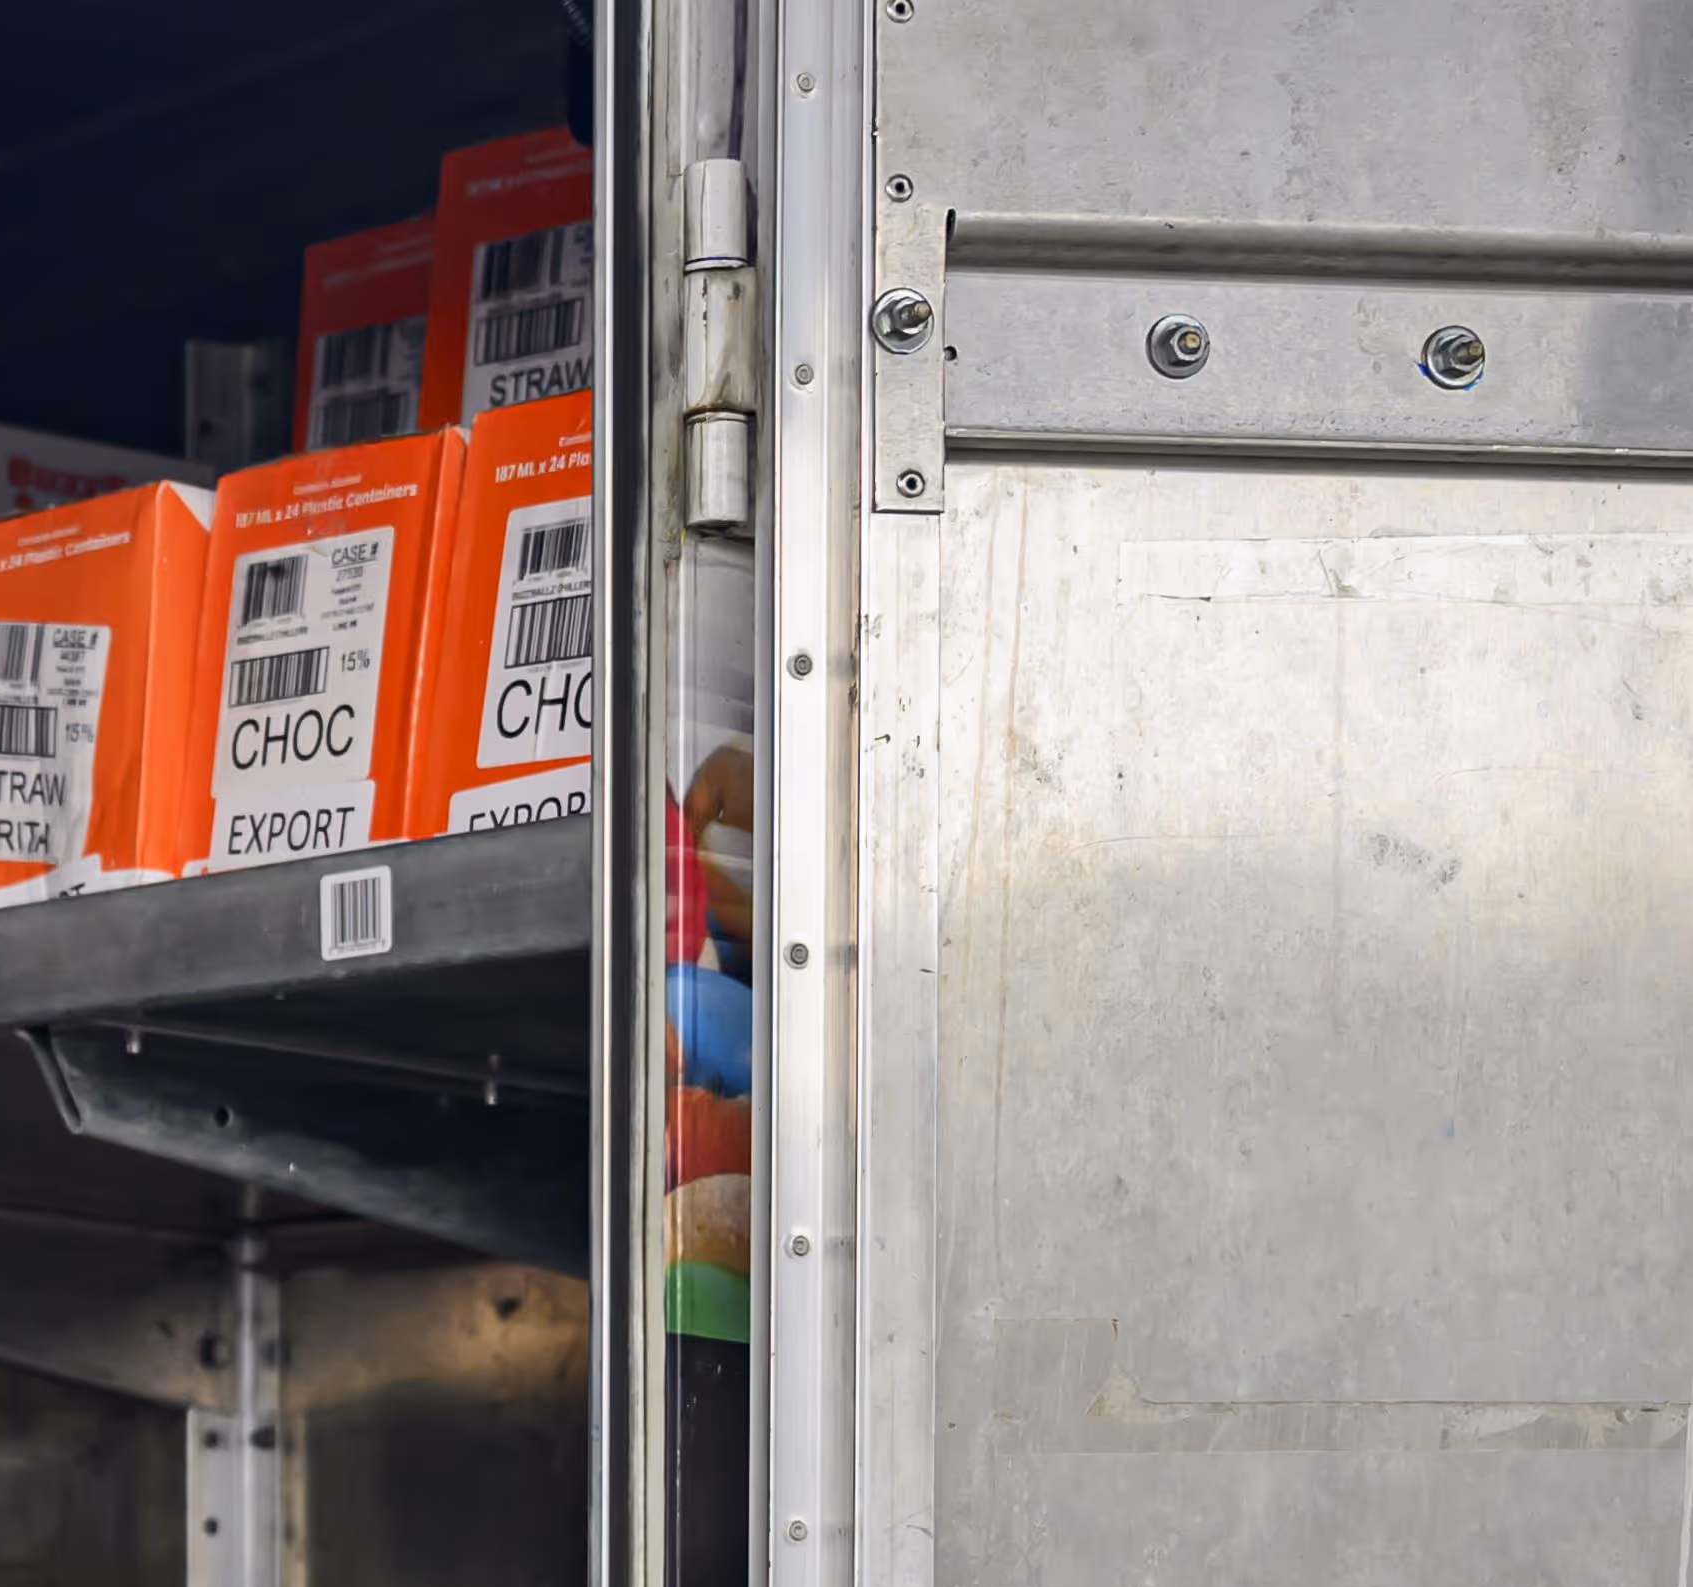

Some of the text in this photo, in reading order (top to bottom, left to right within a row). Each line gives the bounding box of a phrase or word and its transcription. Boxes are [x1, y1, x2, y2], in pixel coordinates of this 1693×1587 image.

[568, 452, 592, 470] Pla
[331, 543, 367, 567] CASE
[339, 648, 371, 672] 15%
[65, 722, 95, 743] 15%
[231, 704, 355, 771] CHOC
[227, 807, 356, 856] EXPORT
